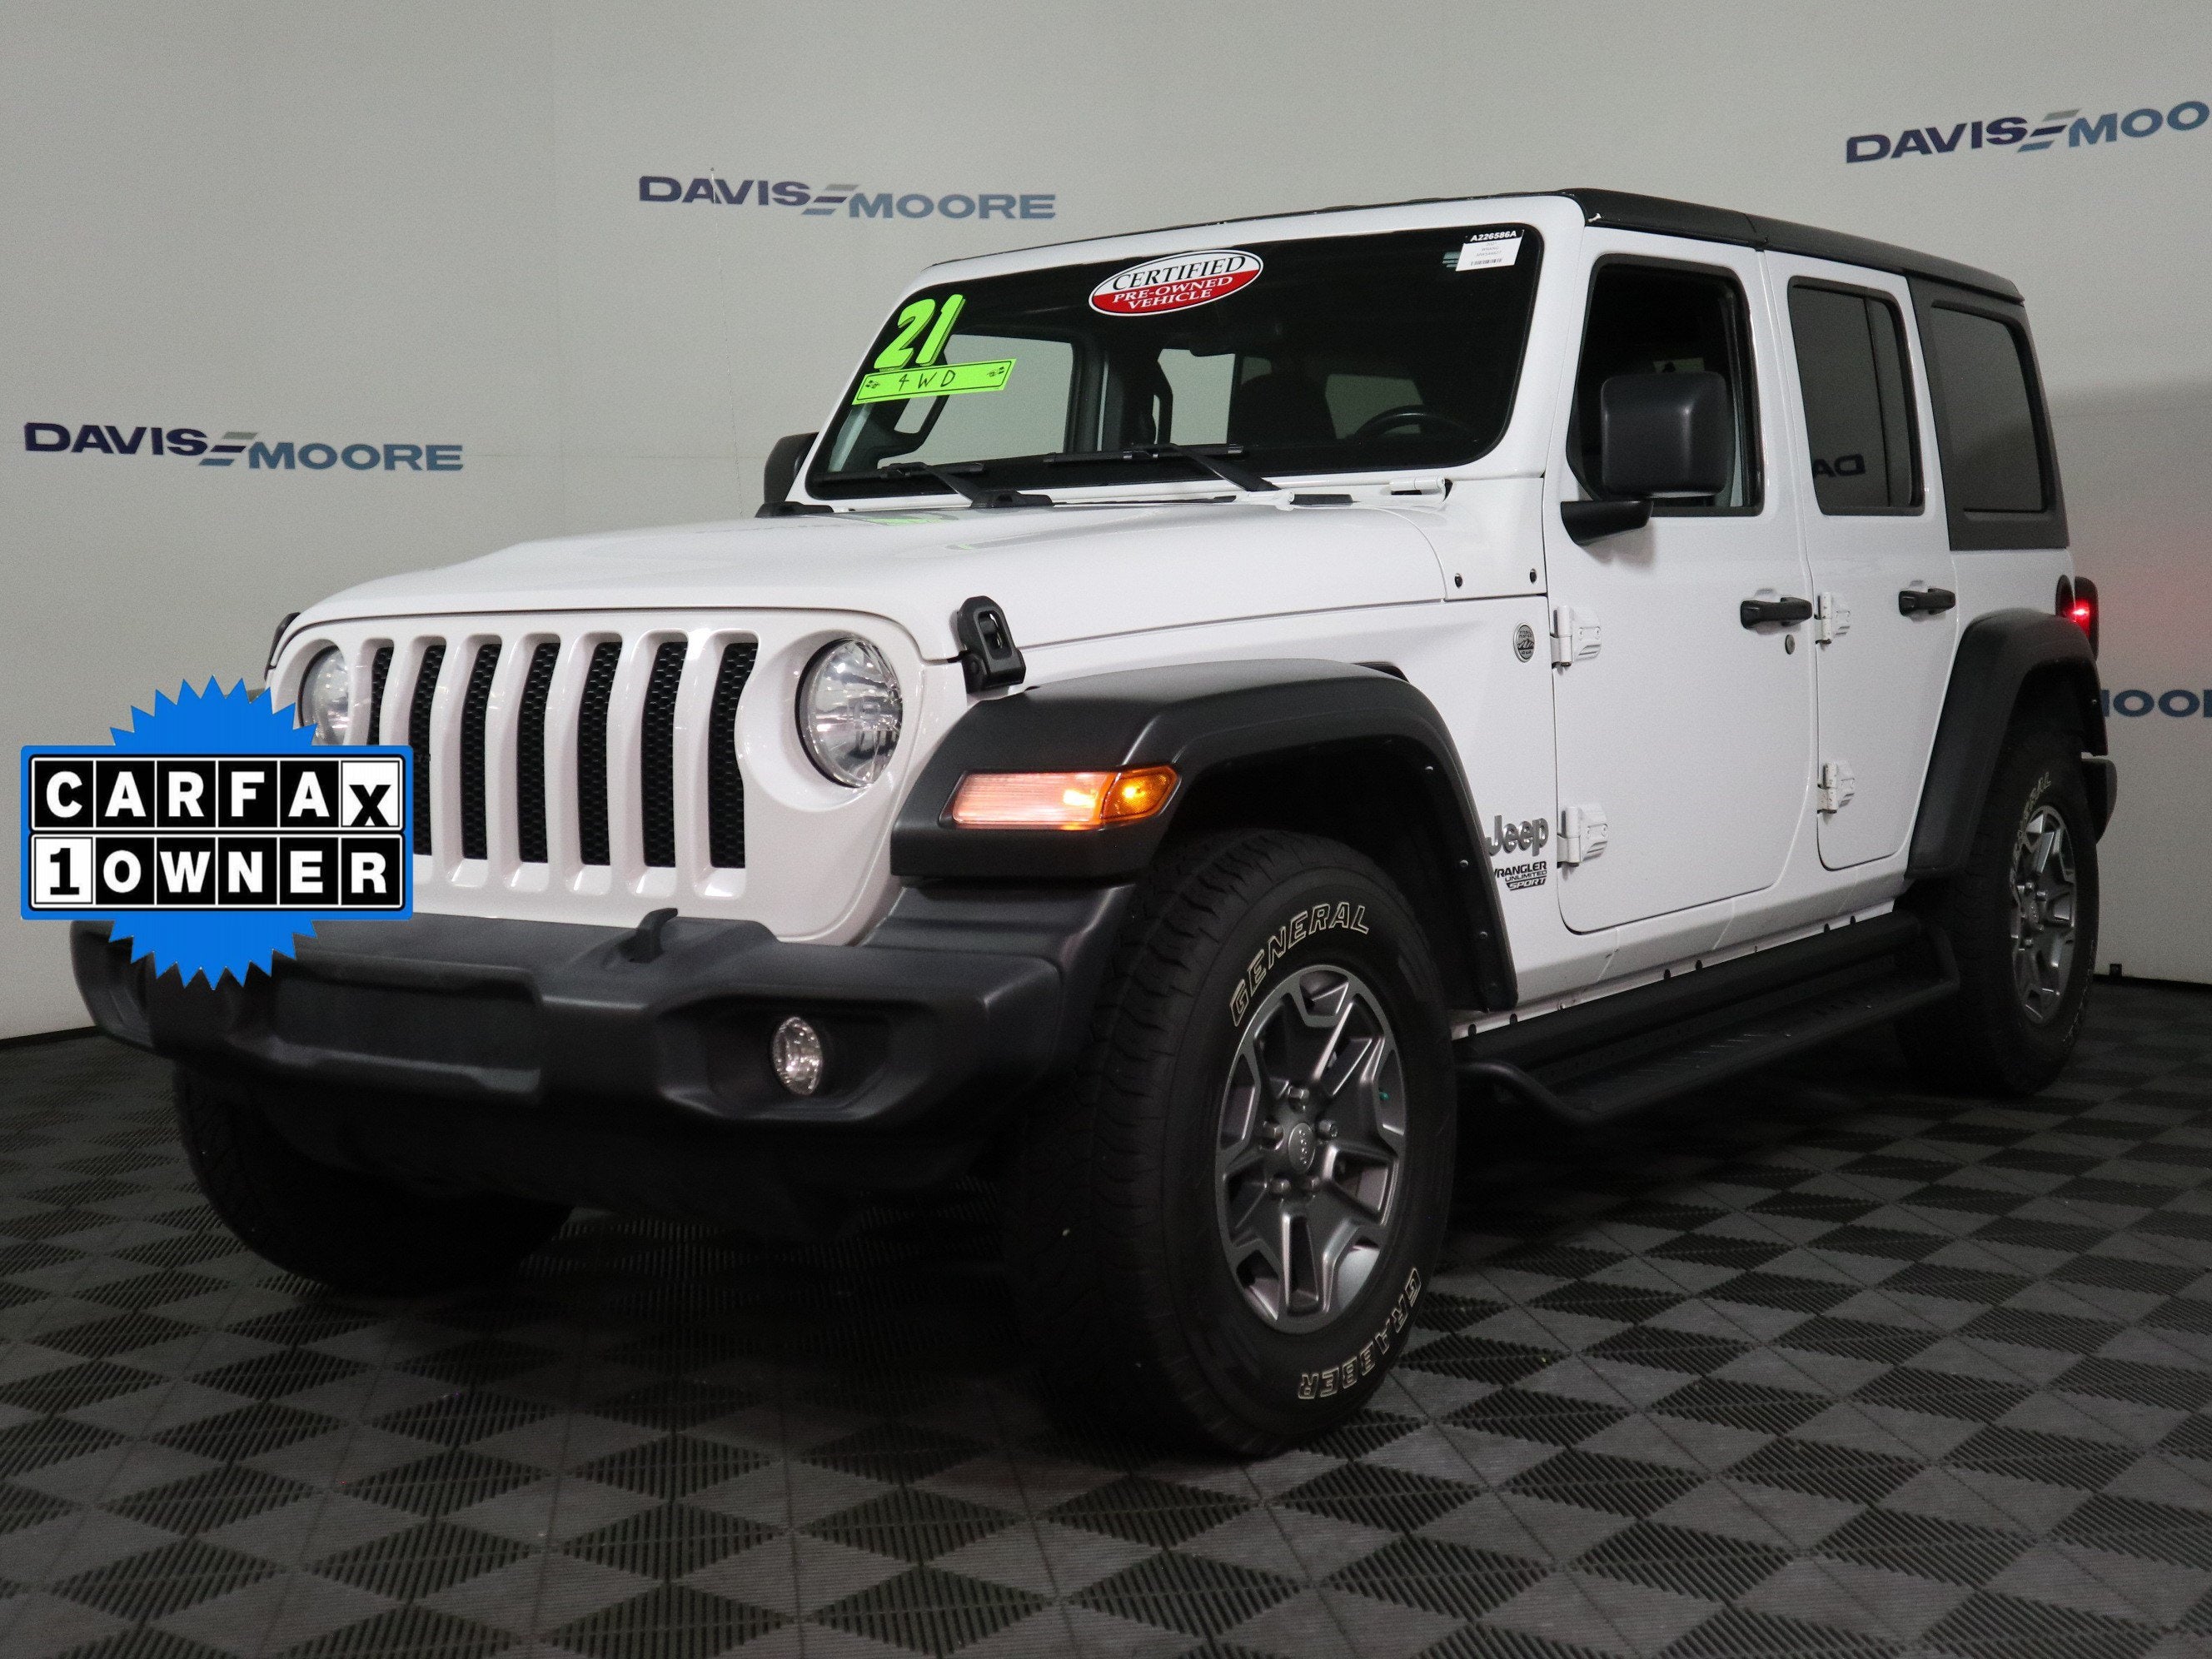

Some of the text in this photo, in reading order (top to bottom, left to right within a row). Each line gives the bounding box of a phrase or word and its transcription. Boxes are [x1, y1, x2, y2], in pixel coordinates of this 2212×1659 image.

[1846, 100, 2211, 163] DAVIS MOO
[639, 176, 1056, 220] DAVIS MOORE
[1470, 230, 1517, 242] A226586A
[1112, 276, 1233, 303] PRE-OWNED
[1113, 255, 1246, 291] CERTIFIED
[1128, 288, 1213, 310] VEHICLE
[874, 294, 966, 372] 21
[23, 421, 464, 471] DAVIS MOORE
[1485, 815, 1549, 857] Jeep
[1508, 877, 1546, 890] SPORT
[1229, 902, 1370, 1028] GENERAL
[1298, 1267, 1422, 1400] GRABBER
